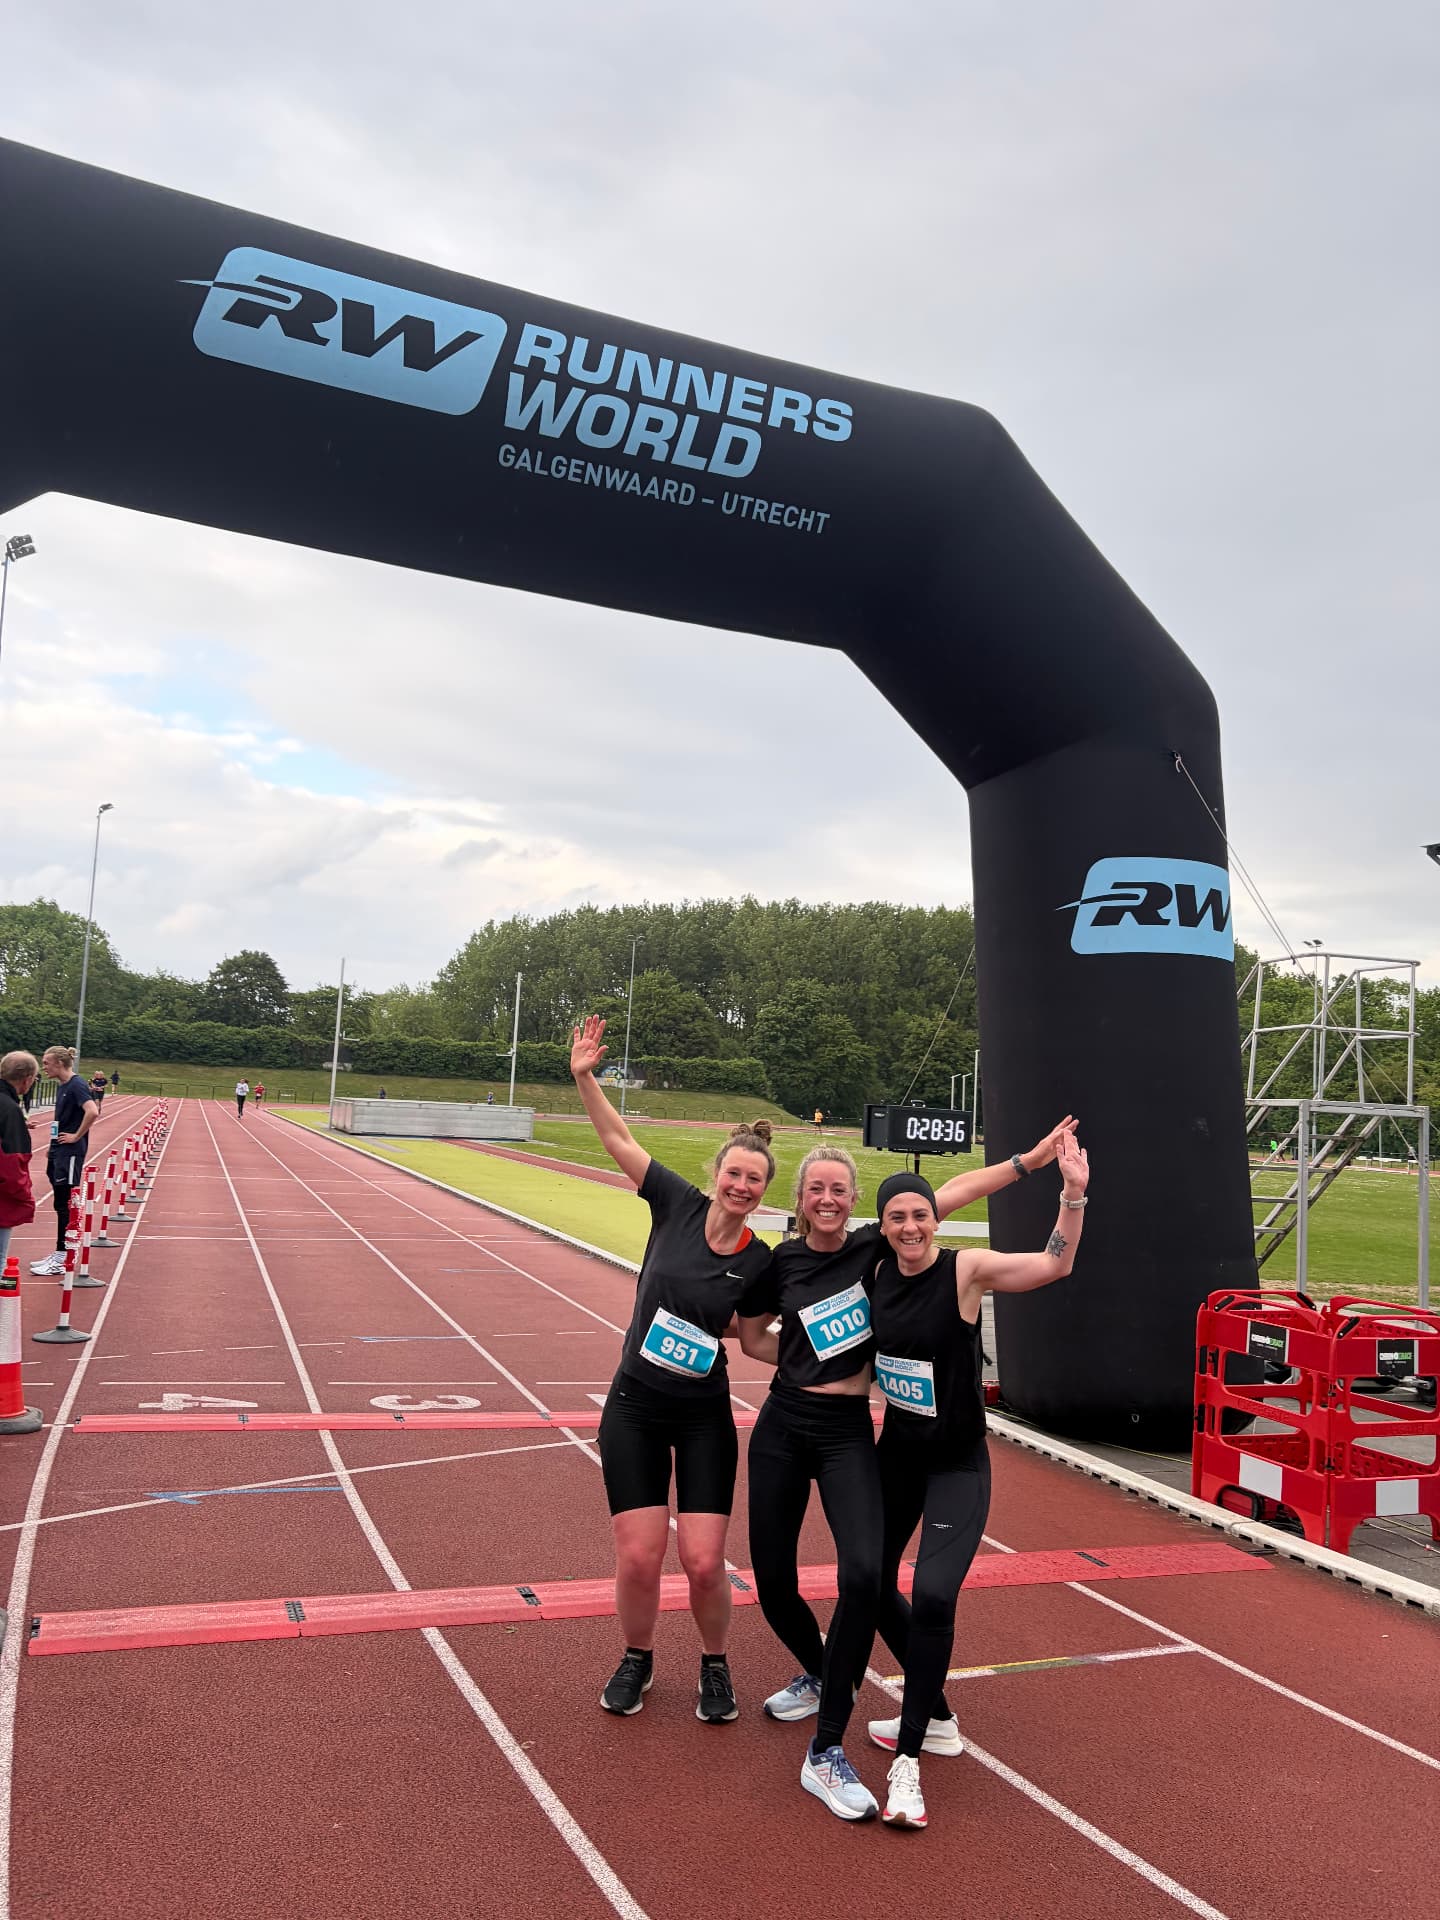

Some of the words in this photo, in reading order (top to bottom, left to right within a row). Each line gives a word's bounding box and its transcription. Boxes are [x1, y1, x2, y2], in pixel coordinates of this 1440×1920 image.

[202, 272, 486, 374] RW
[512, 321, 854, 442] RUNNERS
[503, 371, 762, 480] WORLD
[498, 443, 696, 507] GALGENWAARD
[721, 491, 831, 535] UTRECHT
[1086, 880, 1231, 933] RW
[660, 1336, 699, 1366] 951
[819, 1308, 866, 1342] 1010
[880, 1373, 924, 1400] 1405
